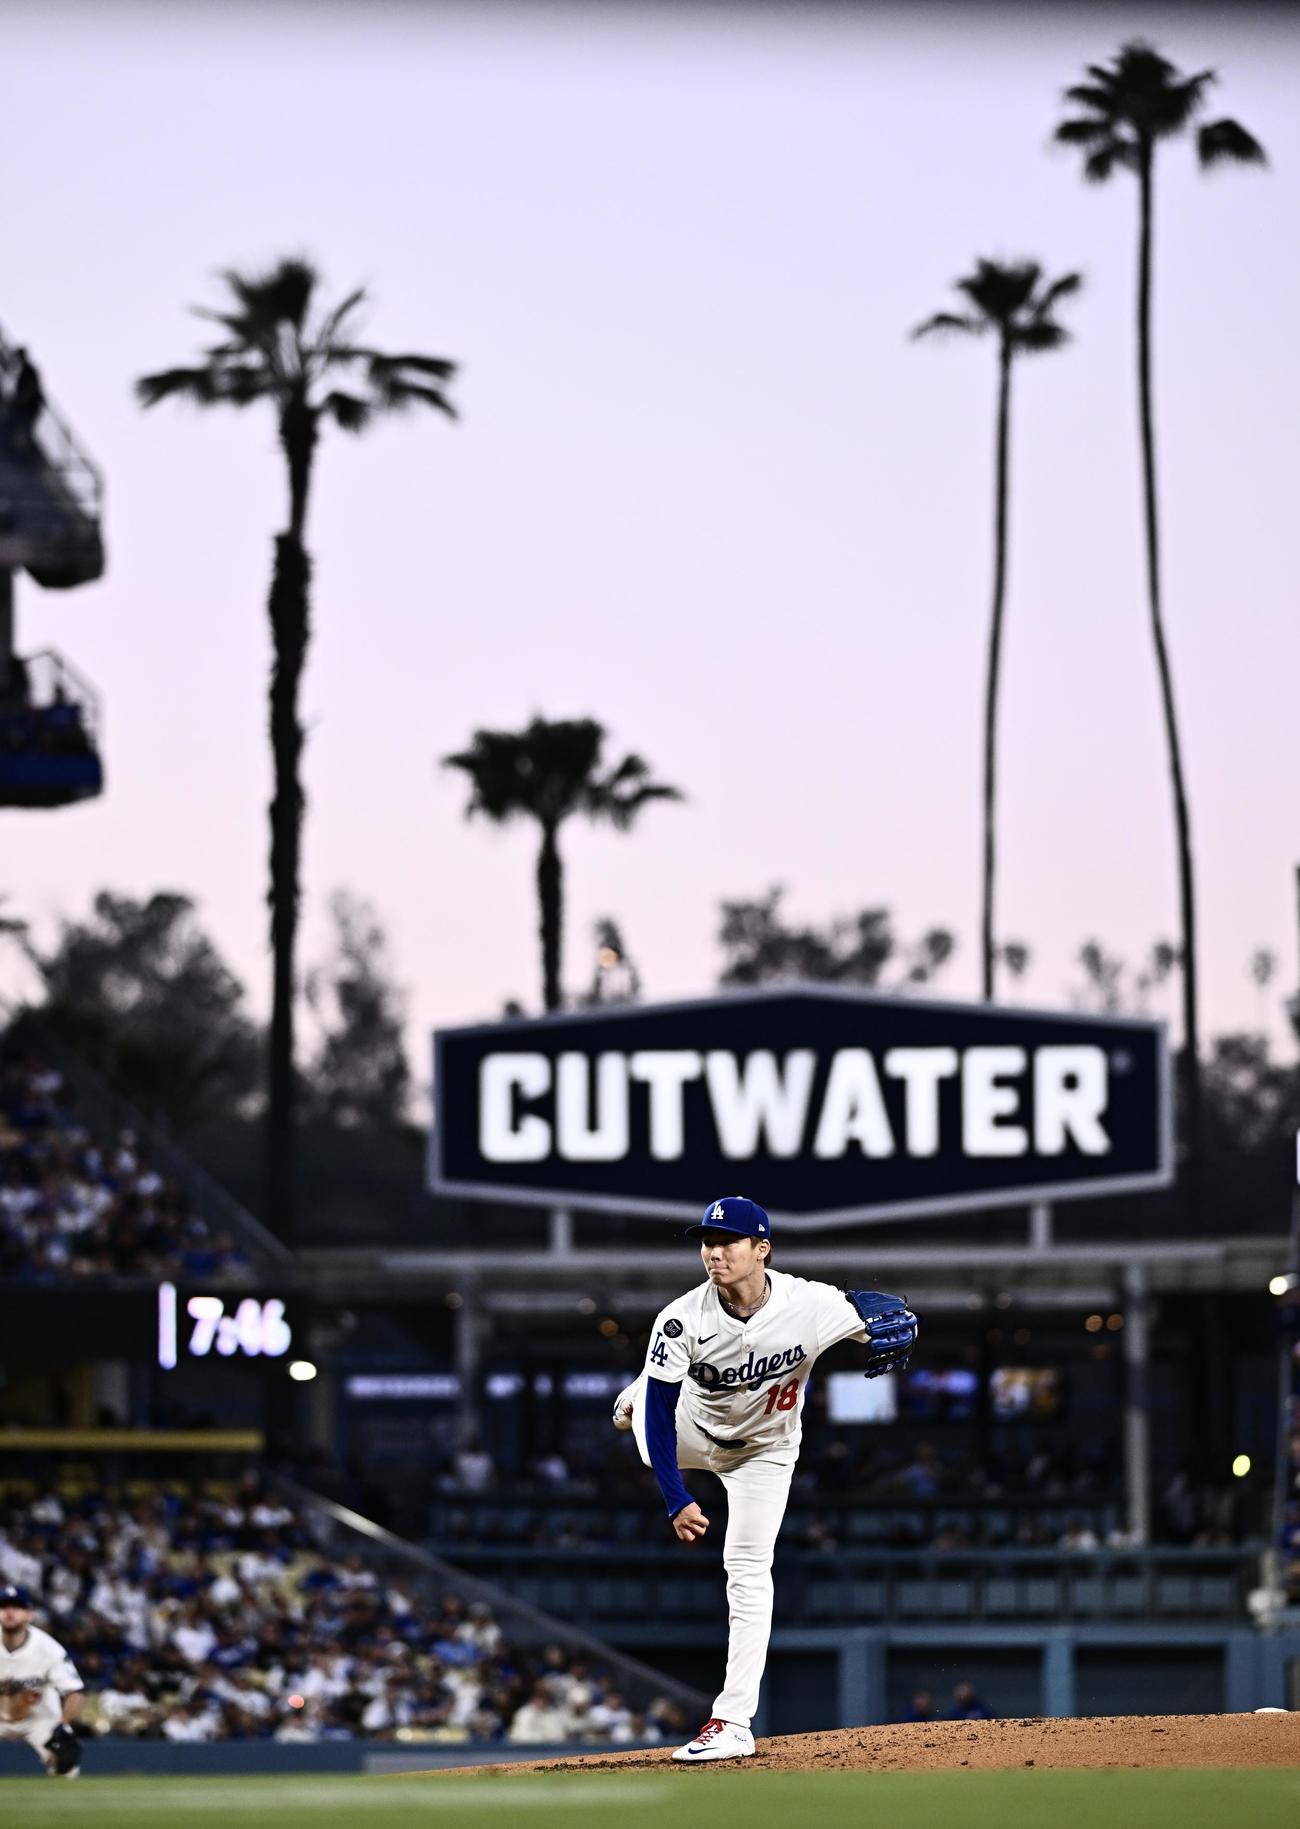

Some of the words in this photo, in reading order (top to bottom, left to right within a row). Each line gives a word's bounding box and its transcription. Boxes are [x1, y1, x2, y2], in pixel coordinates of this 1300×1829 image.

[479, 1046, 1110, 1162] CUTWATER
[711, 1201, 724, 1219] LA
[650, 1332, 668, 1367] LA
[688, 1344, 807, 1394] Dodgers
[764, 1378, 799, 1415] 18
